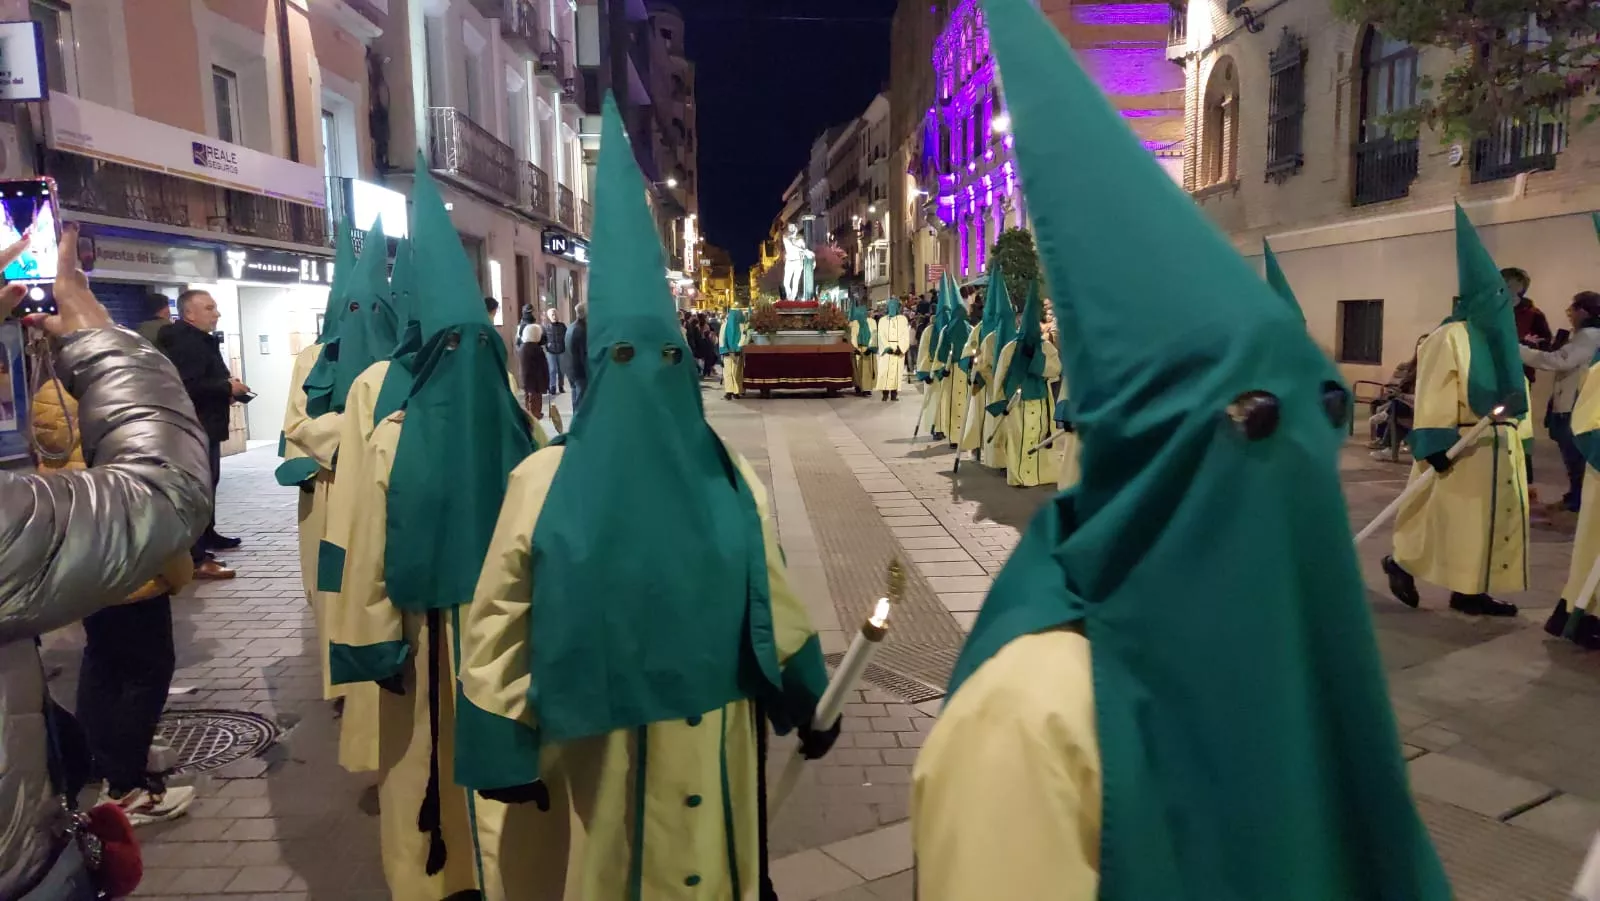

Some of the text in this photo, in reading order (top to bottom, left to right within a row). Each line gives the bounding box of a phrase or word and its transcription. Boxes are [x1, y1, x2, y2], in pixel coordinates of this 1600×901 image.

[206, 145, 238, 165] REALE
[207, 159, 239, 175] SEGUROS
[552, 239, 566, 251] IN
[96, 247, 135, 262] Apuestas
[136, 251, 149, 264] del
[301, 259, 320, 281] EL
